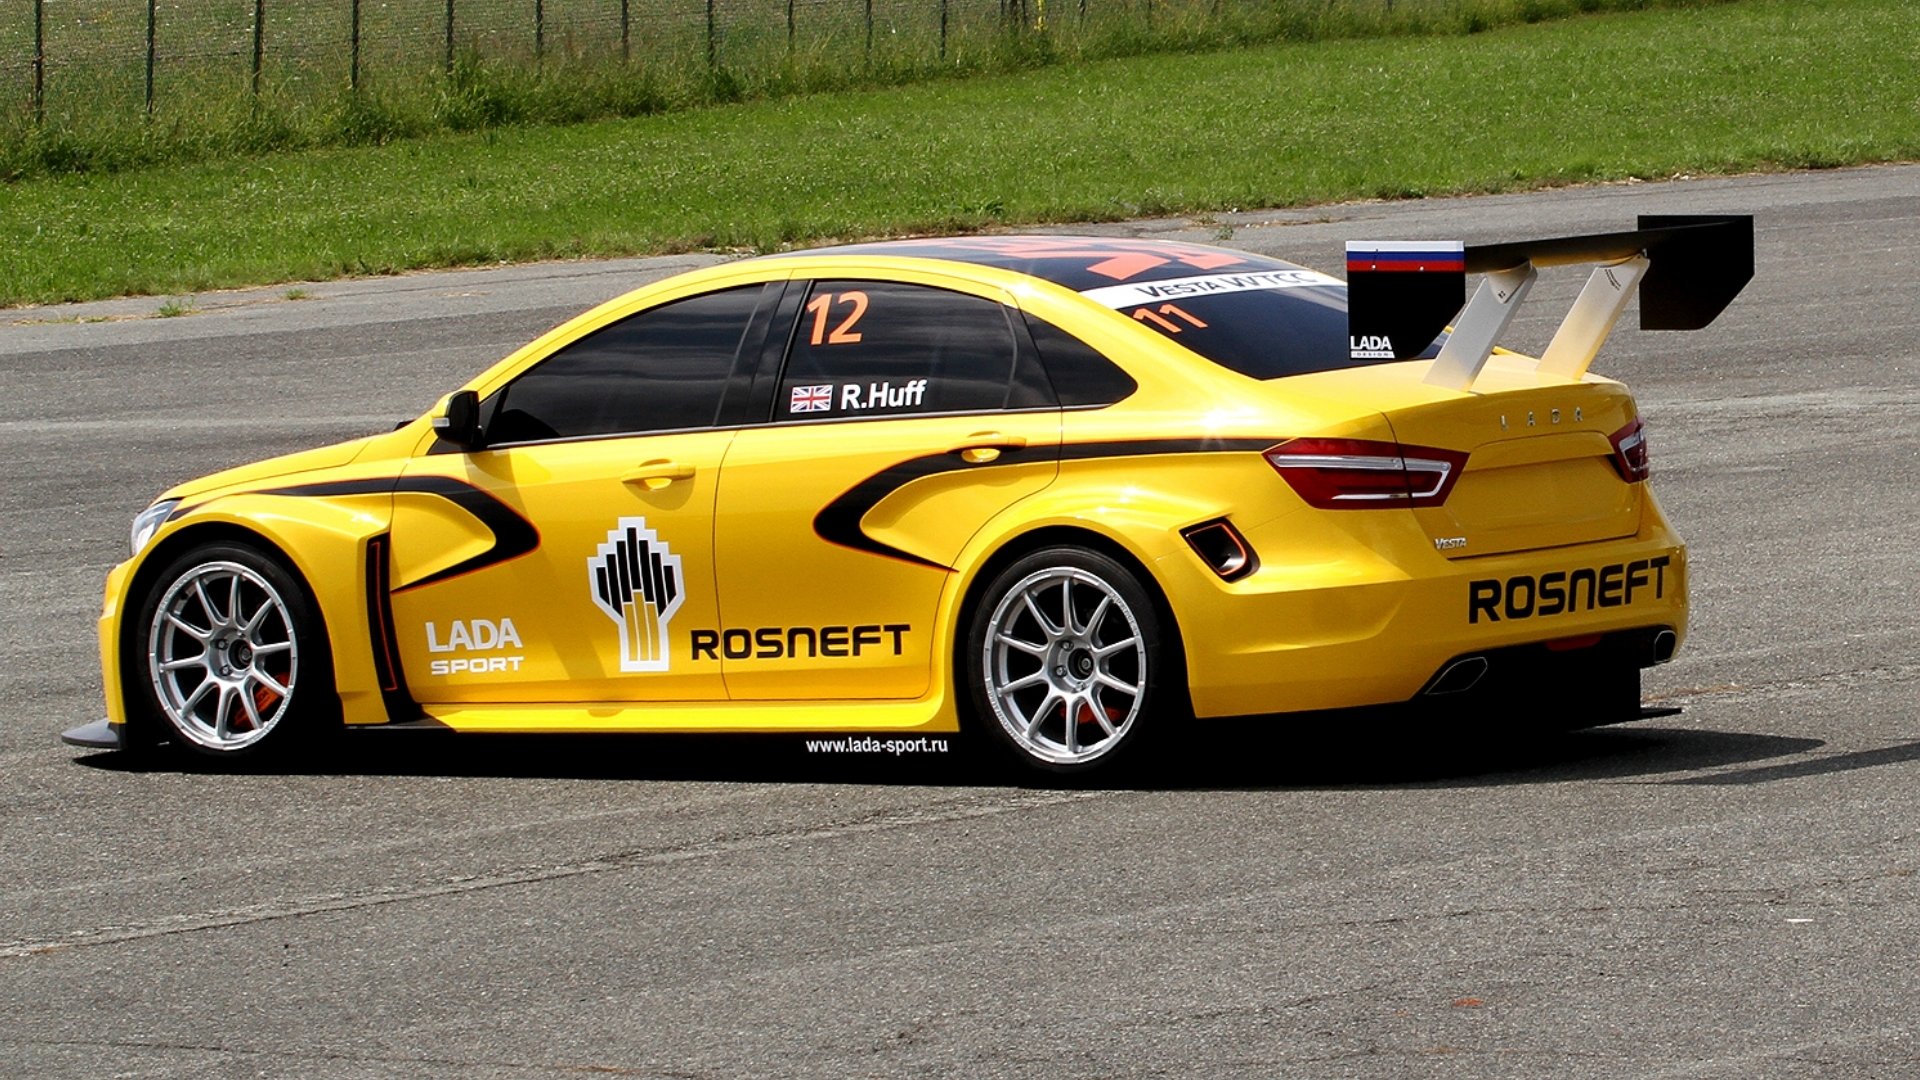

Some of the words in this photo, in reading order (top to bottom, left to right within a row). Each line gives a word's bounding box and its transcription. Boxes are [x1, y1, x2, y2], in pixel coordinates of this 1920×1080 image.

[1136, 281, 1222, 297] VESTA
[806, 290, 869, 345] 12
[1133, 303, 1208, 333] 11
[1350, 335, 1393, 351] LADA
[840, 379, 927, 410] R.Huff
[1500, 405, 1583, 431] LADA
[1434, 537, 1467, 550] VESTA
[1468, 555, 1671, 624] ROSNEFT
[425, 618, 523, 653] LADA
[691, 625, 910, 660] ROSNEFT
[430, 656, 524, 675] SPORT
[805, 736, 949, 757] www.lada-sport.ru
